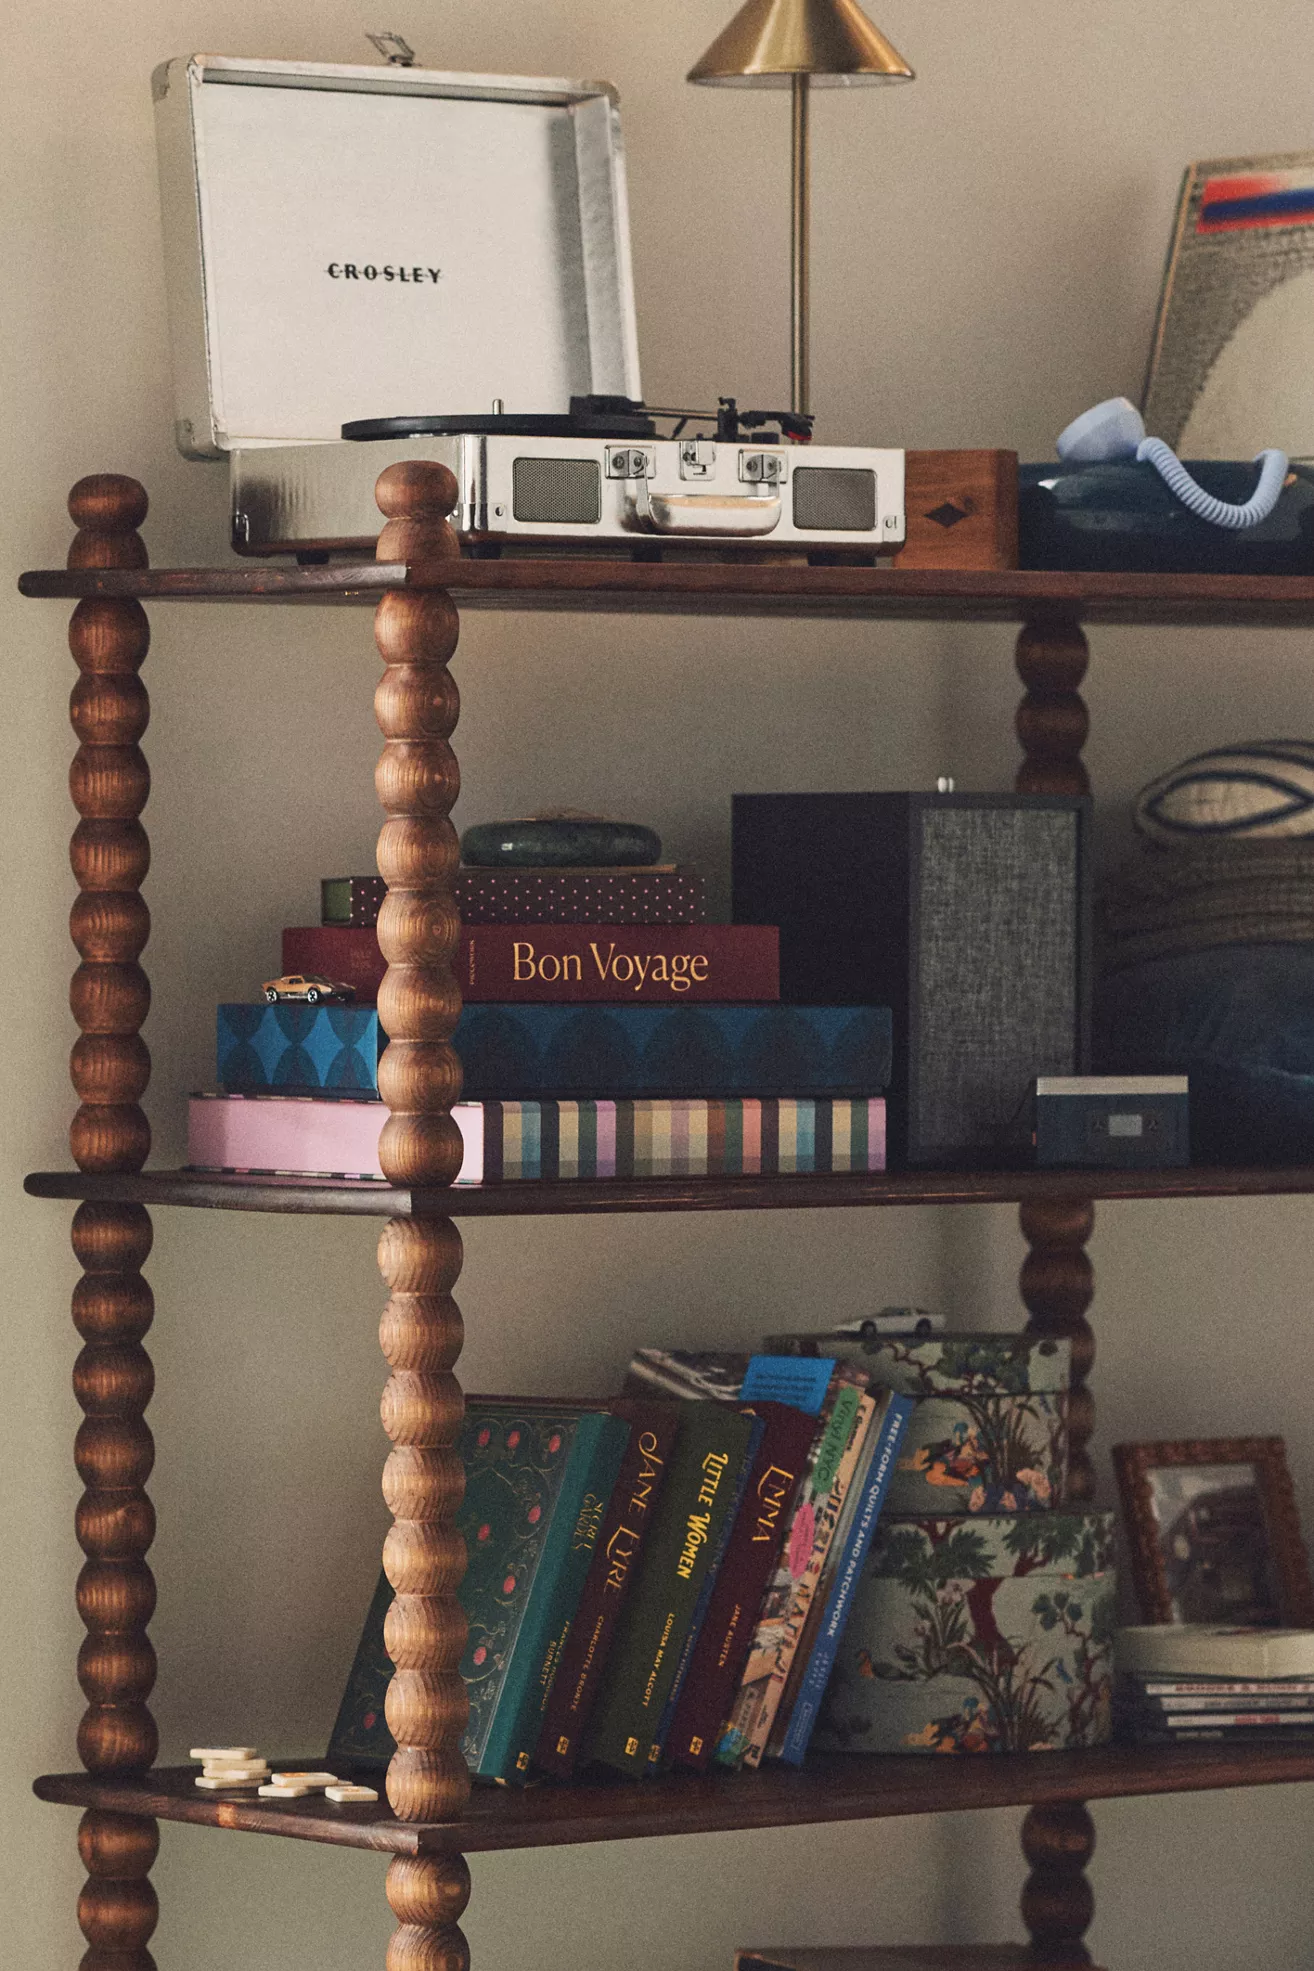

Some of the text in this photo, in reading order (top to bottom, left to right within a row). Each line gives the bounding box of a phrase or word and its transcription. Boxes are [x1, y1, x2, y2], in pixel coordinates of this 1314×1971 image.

[327, 263, 441, 283] CROSLEY
[512, 942, 709, 992] Bon Voyage
[697, 1452, 729, 1507] LITTLE
[817, 1441, 838, 1482] NYC
[603, 1431, 664, 1595] JANE EYRE
[752, 1464, 794, 1540] EMMA
[827, 1412, 903, 1638] FREE-FORM QUILTS AND PATCHWORK
[677, 1512, 711, 1579] WOMEN
[540, 1640, 557, 1685] BURNETT
[583, 1615, 605, 1670] CHARLOTTE
[642, 1612, 675, 1708] LOUISA MAY ALCOTT
[717, 1603, 742, 1668] JANE AUSTEN
